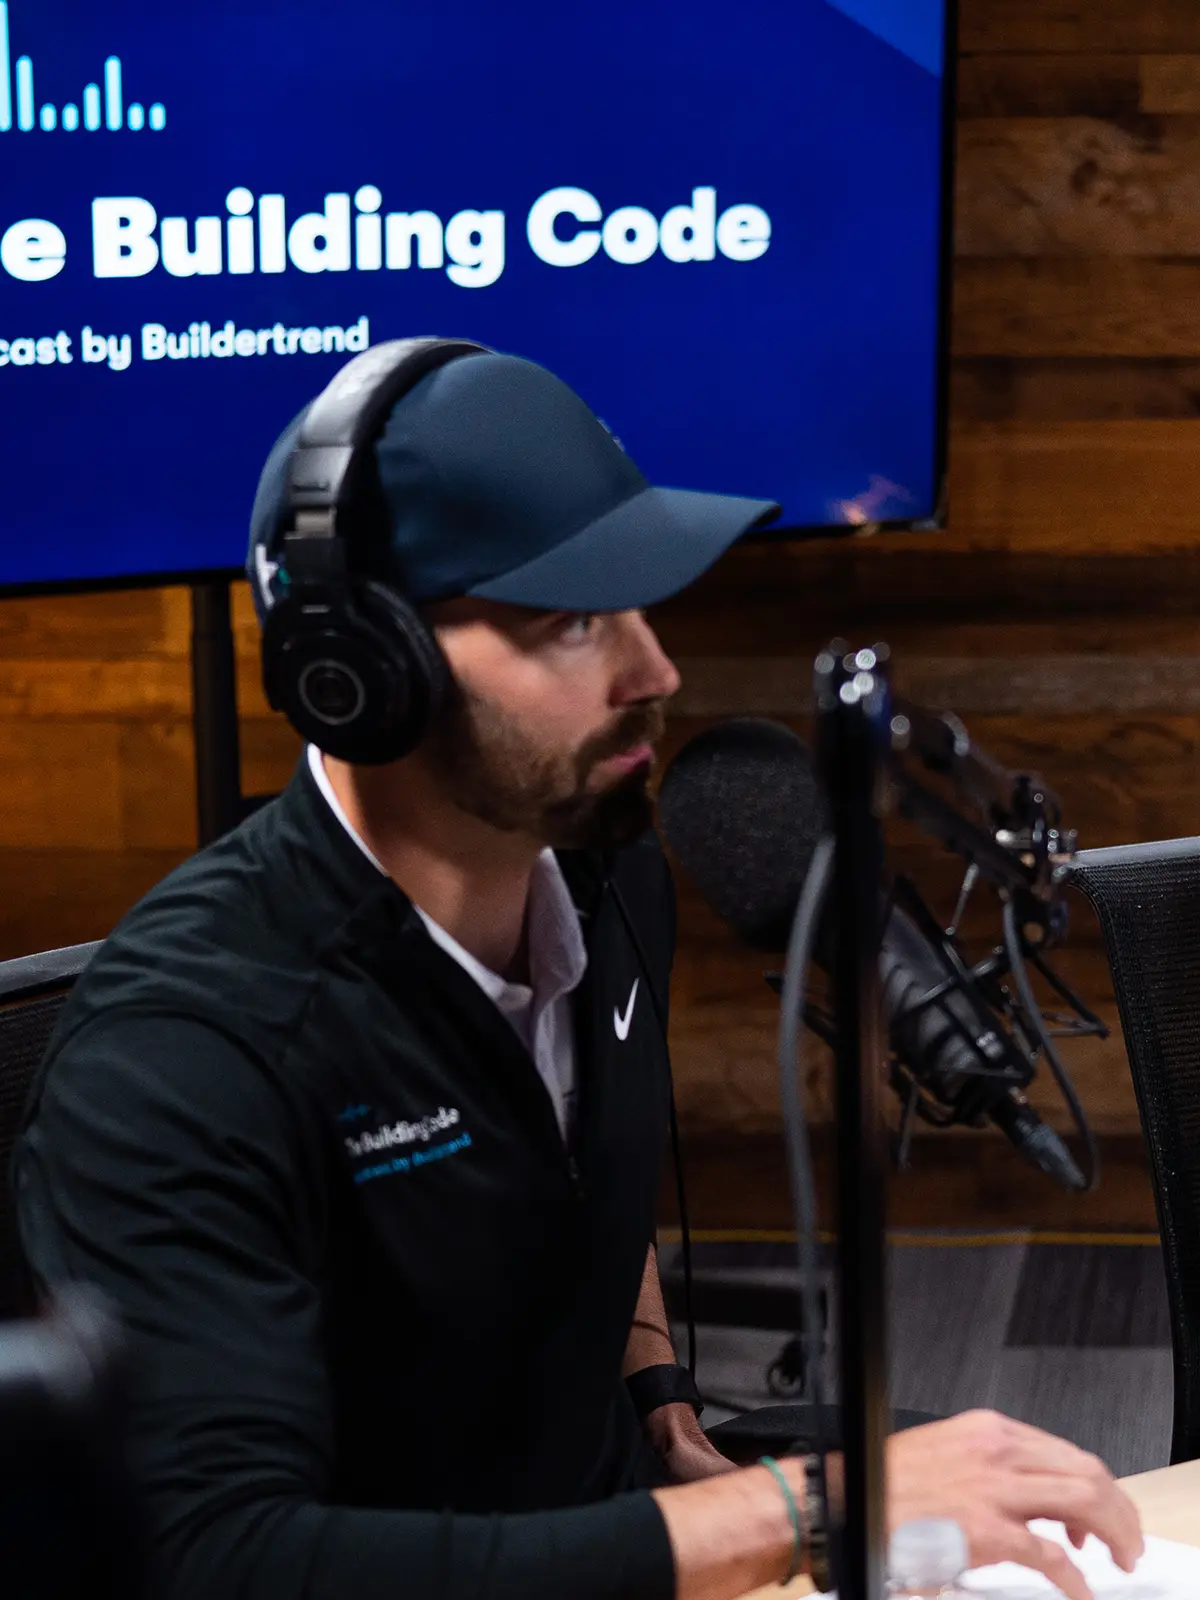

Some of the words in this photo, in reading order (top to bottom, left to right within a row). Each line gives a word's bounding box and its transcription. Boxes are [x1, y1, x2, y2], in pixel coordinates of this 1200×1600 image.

[91, 185, 505, 289] Building
[527, 186, 772, 268] Code
[81, 325, 132, 371] by
[141, 315, 369, 360] Buildertrend
